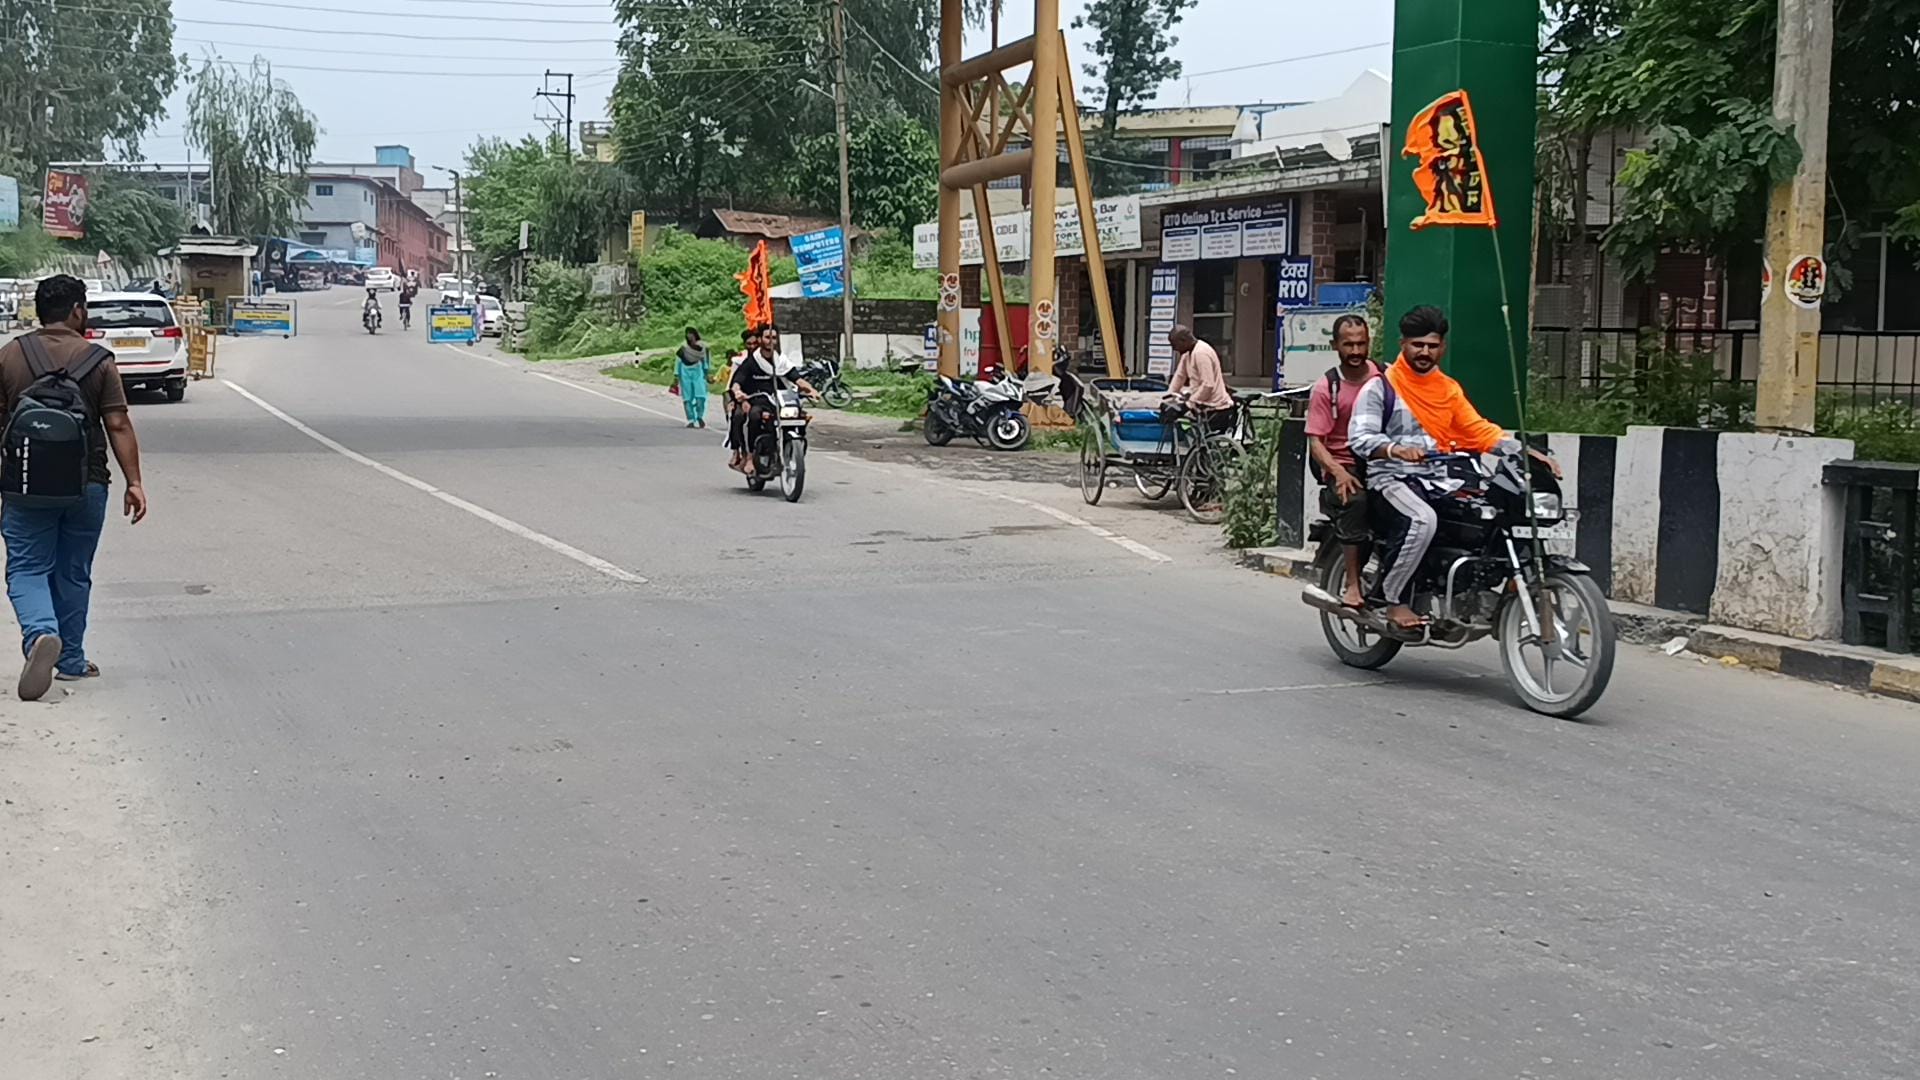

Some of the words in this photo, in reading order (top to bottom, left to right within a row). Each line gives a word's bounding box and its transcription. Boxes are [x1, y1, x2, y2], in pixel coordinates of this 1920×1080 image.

[1100, 203, 1118, 214] Bar
[1164, 213, 1180, 227] RTO
[1182, 211, 1209, 225] Online
[1227, 205, 1262, 221] Service
[996, 224, 1018, 236] CIDER
[1278, 280, 1308, 299] RTO
